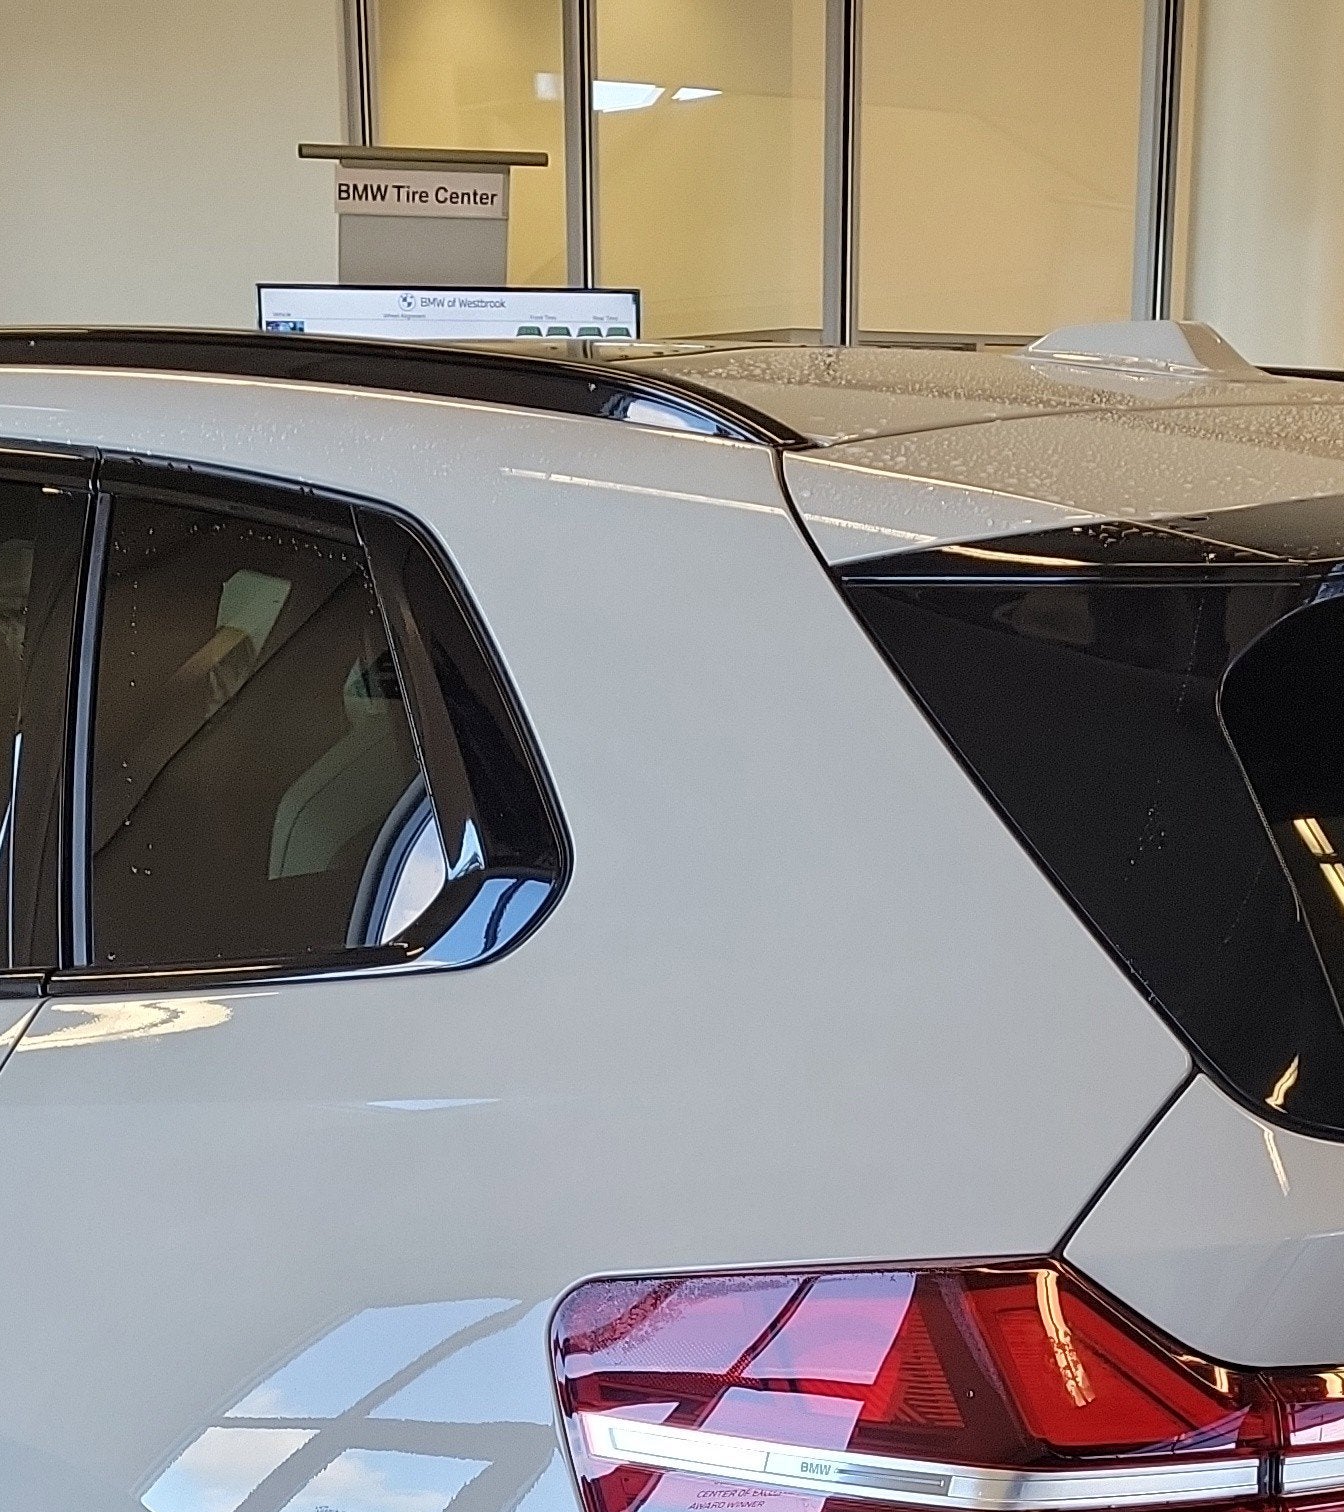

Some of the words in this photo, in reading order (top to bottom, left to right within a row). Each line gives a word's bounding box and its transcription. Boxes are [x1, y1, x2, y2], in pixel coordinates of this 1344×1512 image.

[338, 183, 388, 202] BMW
[392, 184, 429, 204] Tire
[434, 186, 498, 206] Center
[420, 297, 445, 308] BMW
[458, 298, 507, 309] Westbrook
[800, 1461, 831, 1475] BMW
